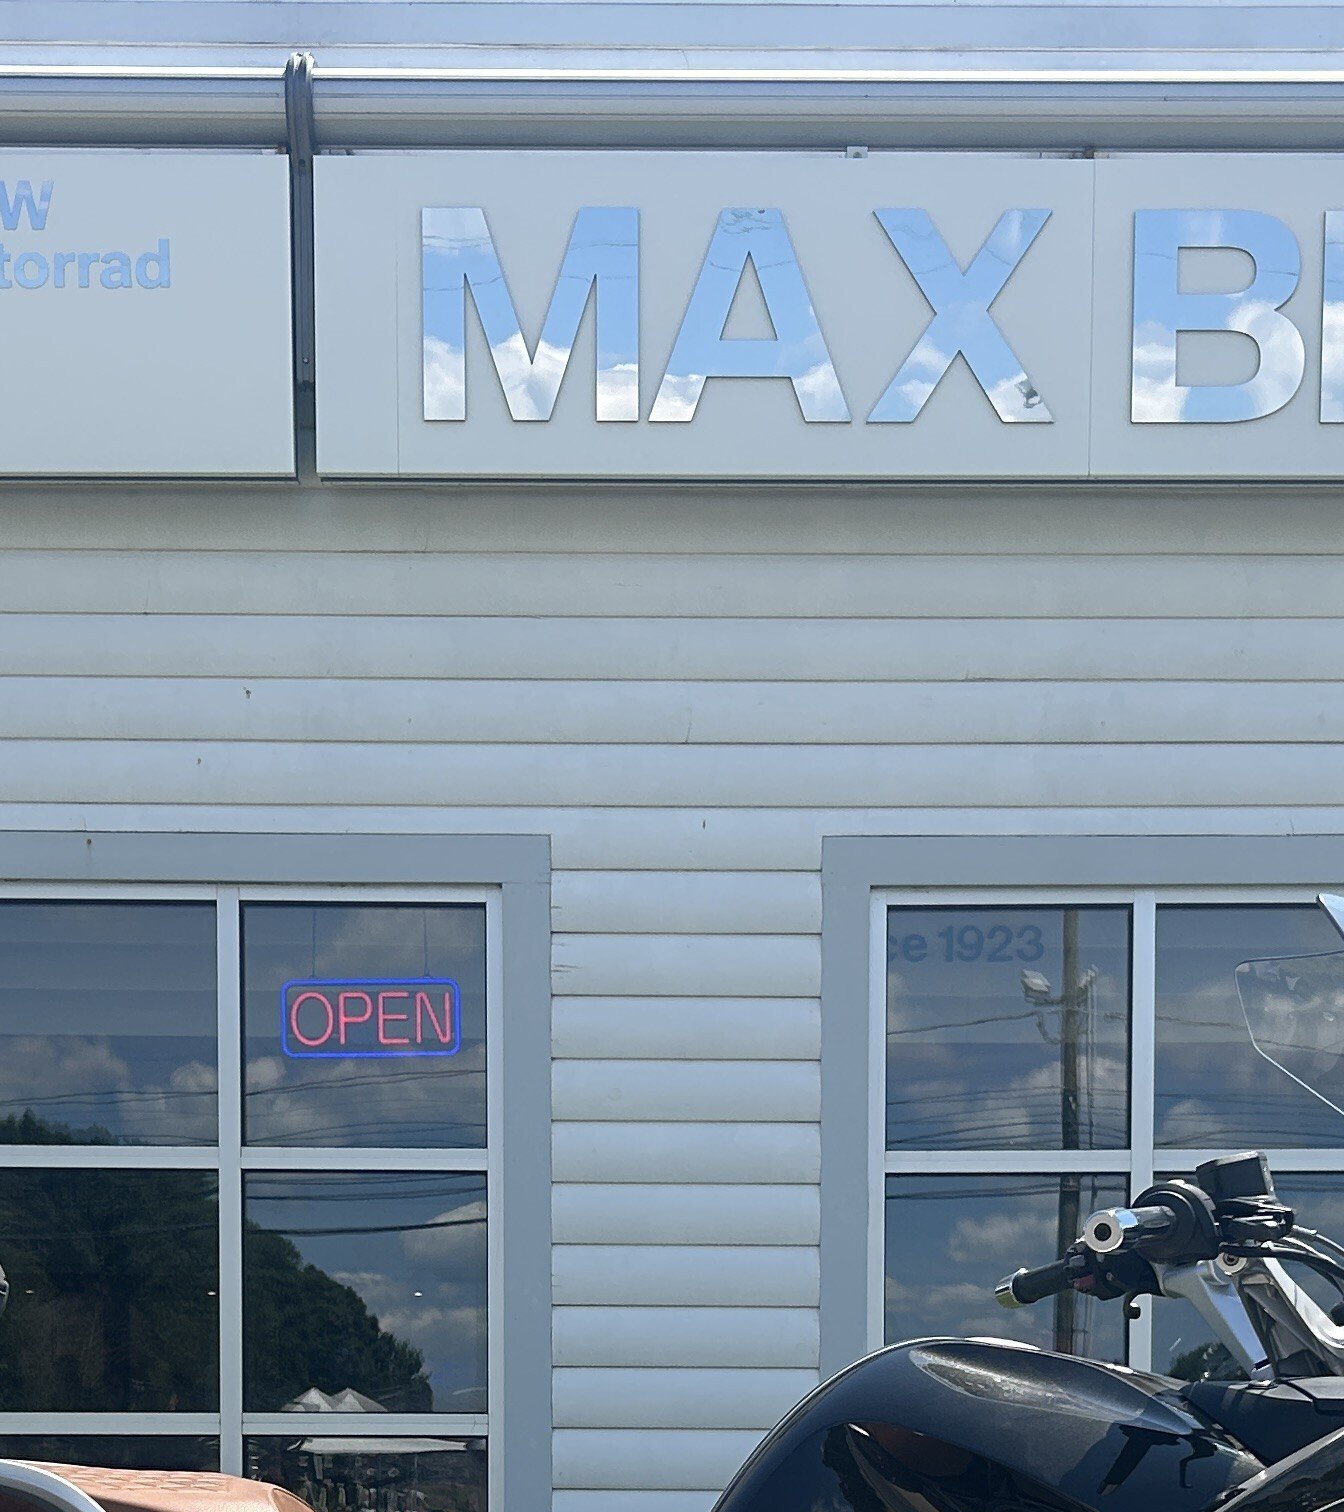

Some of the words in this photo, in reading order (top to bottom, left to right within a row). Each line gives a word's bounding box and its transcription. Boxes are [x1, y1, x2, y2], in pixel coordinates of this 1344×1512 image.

[420, 206, 1056, 425] MAX
[938, 925, 1044, 962] 1923
[290, 991, 452, 1047] OPEN
